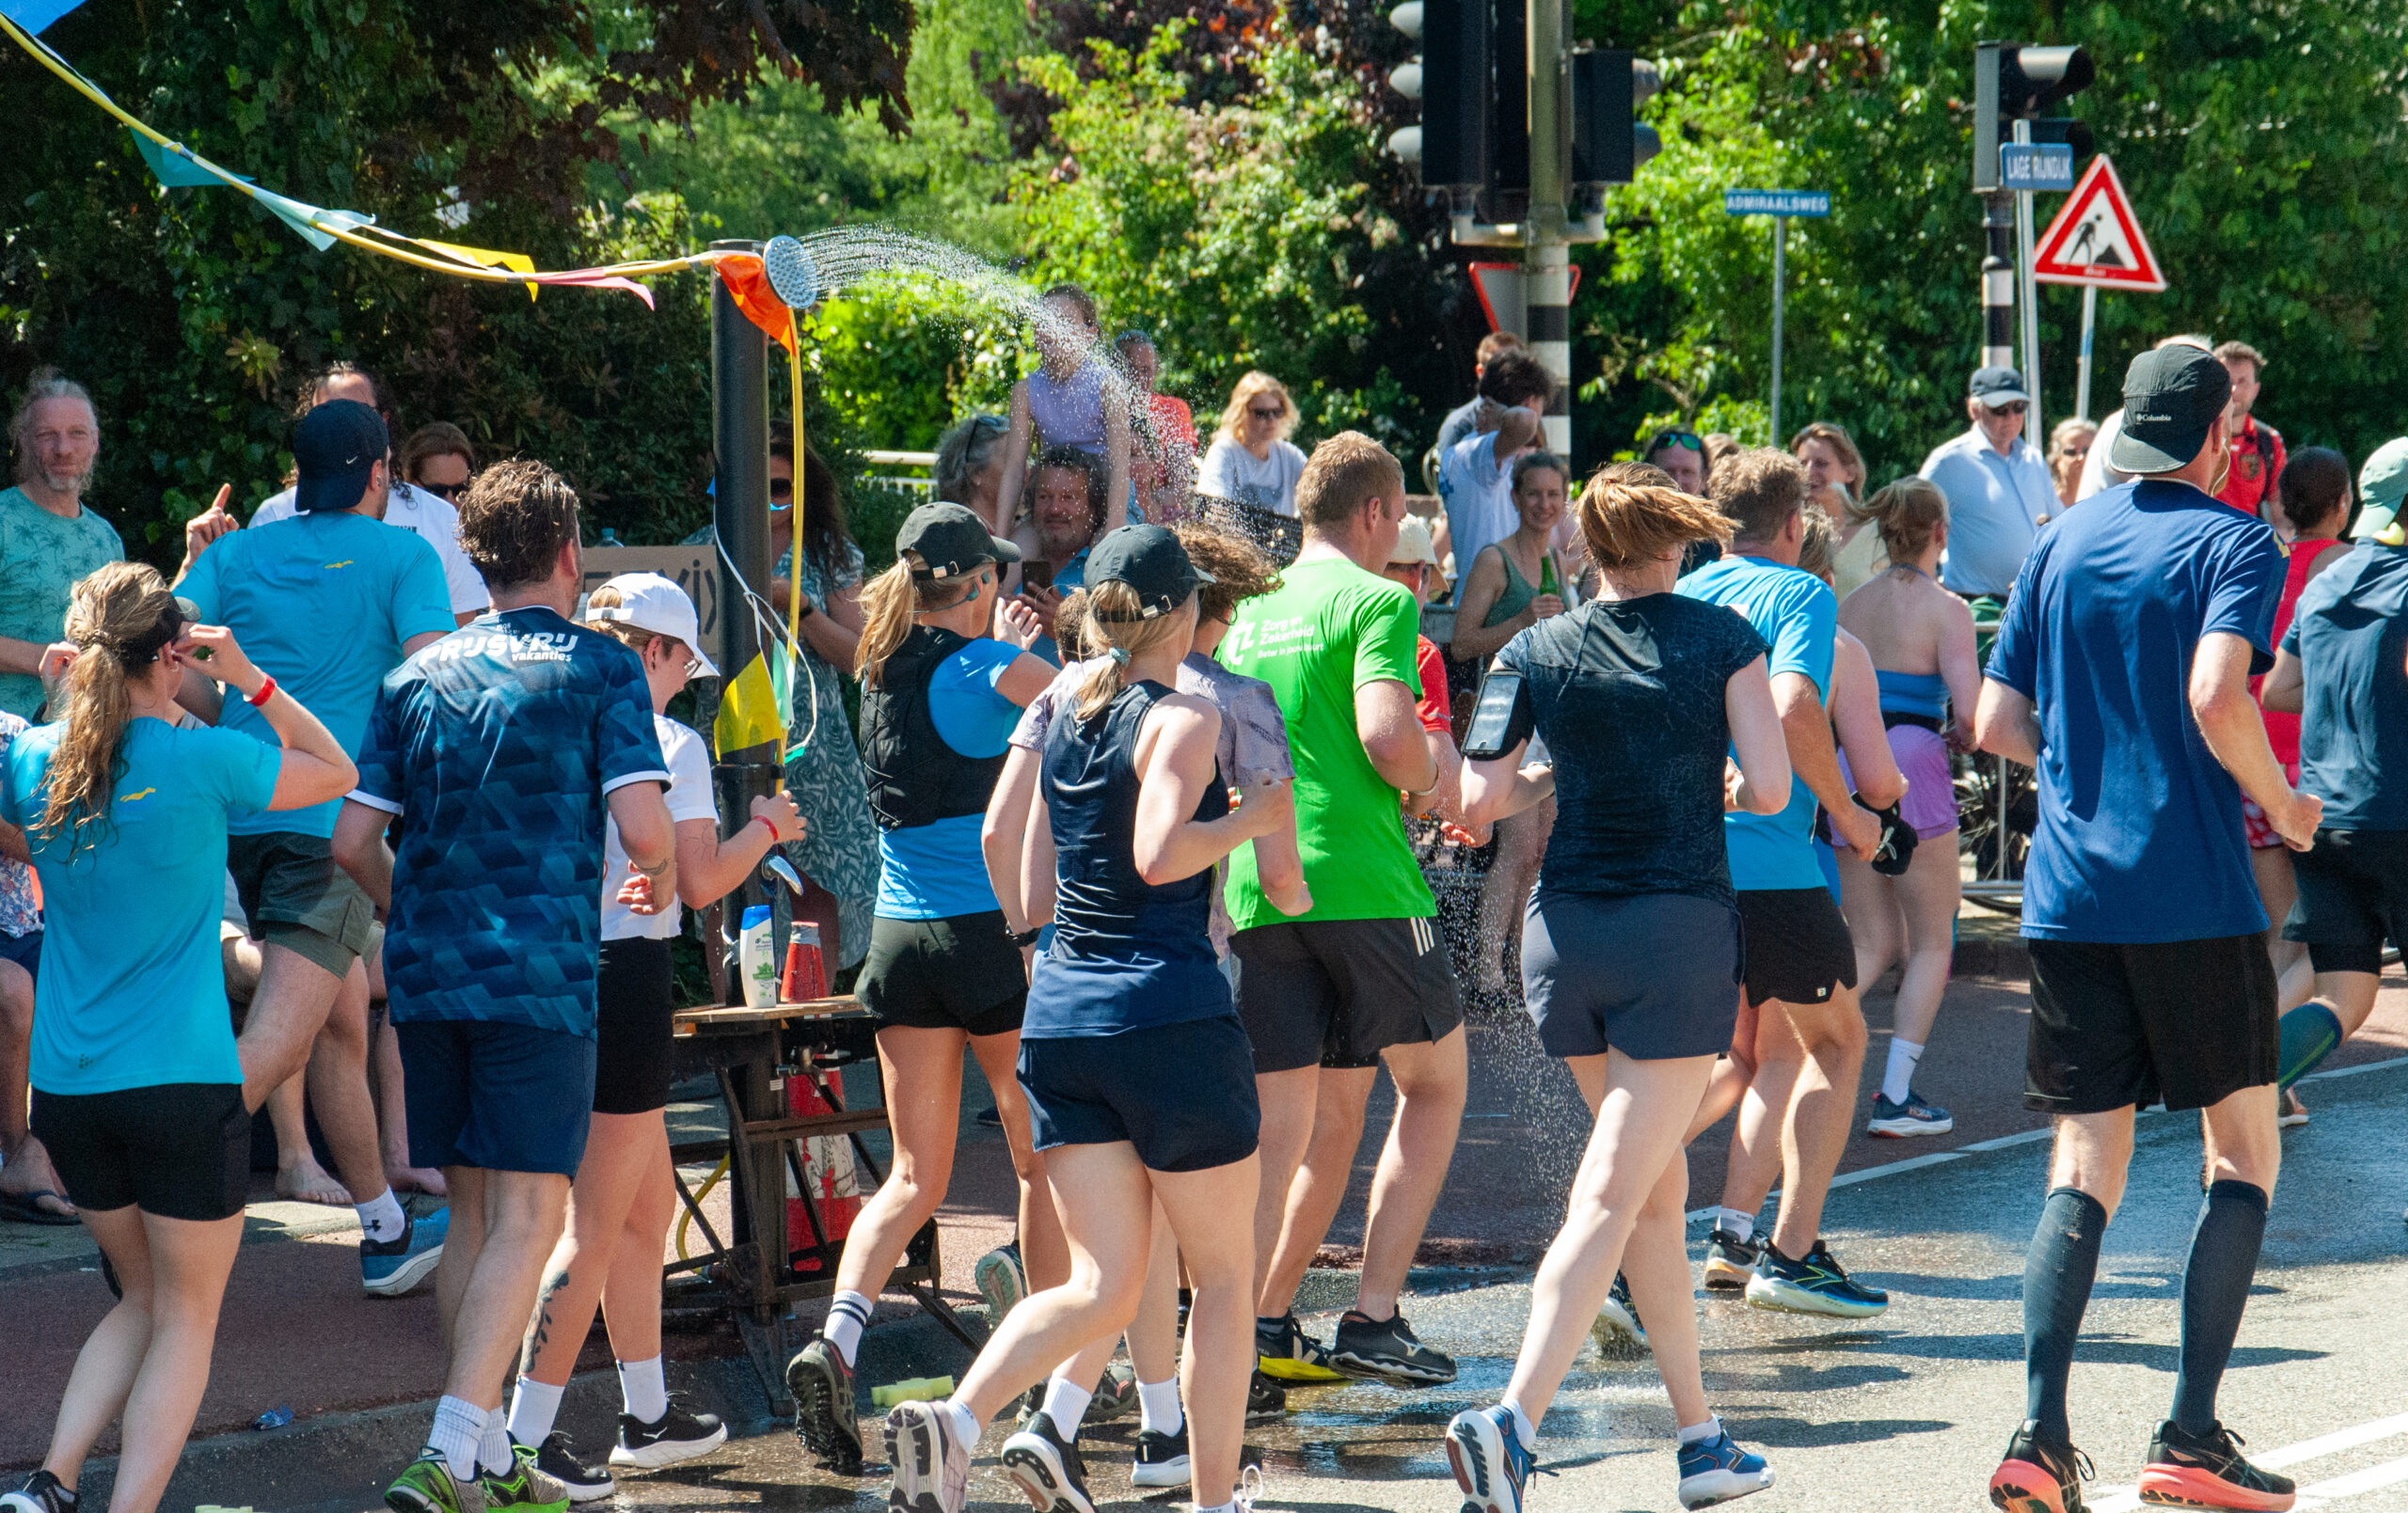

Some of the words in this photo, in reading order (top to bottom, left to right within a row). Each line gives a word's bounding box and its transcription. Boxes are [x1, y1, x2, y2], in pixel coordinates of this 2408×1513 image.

[2007, 155, 2031, 180] LAGE
[1727, 195, 1829, 213] ADMIRAALSWEG
[1261, 619, 1289, 633] Zorg
[1290, 616, 1303, 626] en
[1259, 624, 1315, 645] Zekerheid
[512, 651, 572, 662] vakanties
[1257, 649, 1278, 659] Beter
[1279, 646, 1286, 655] in
